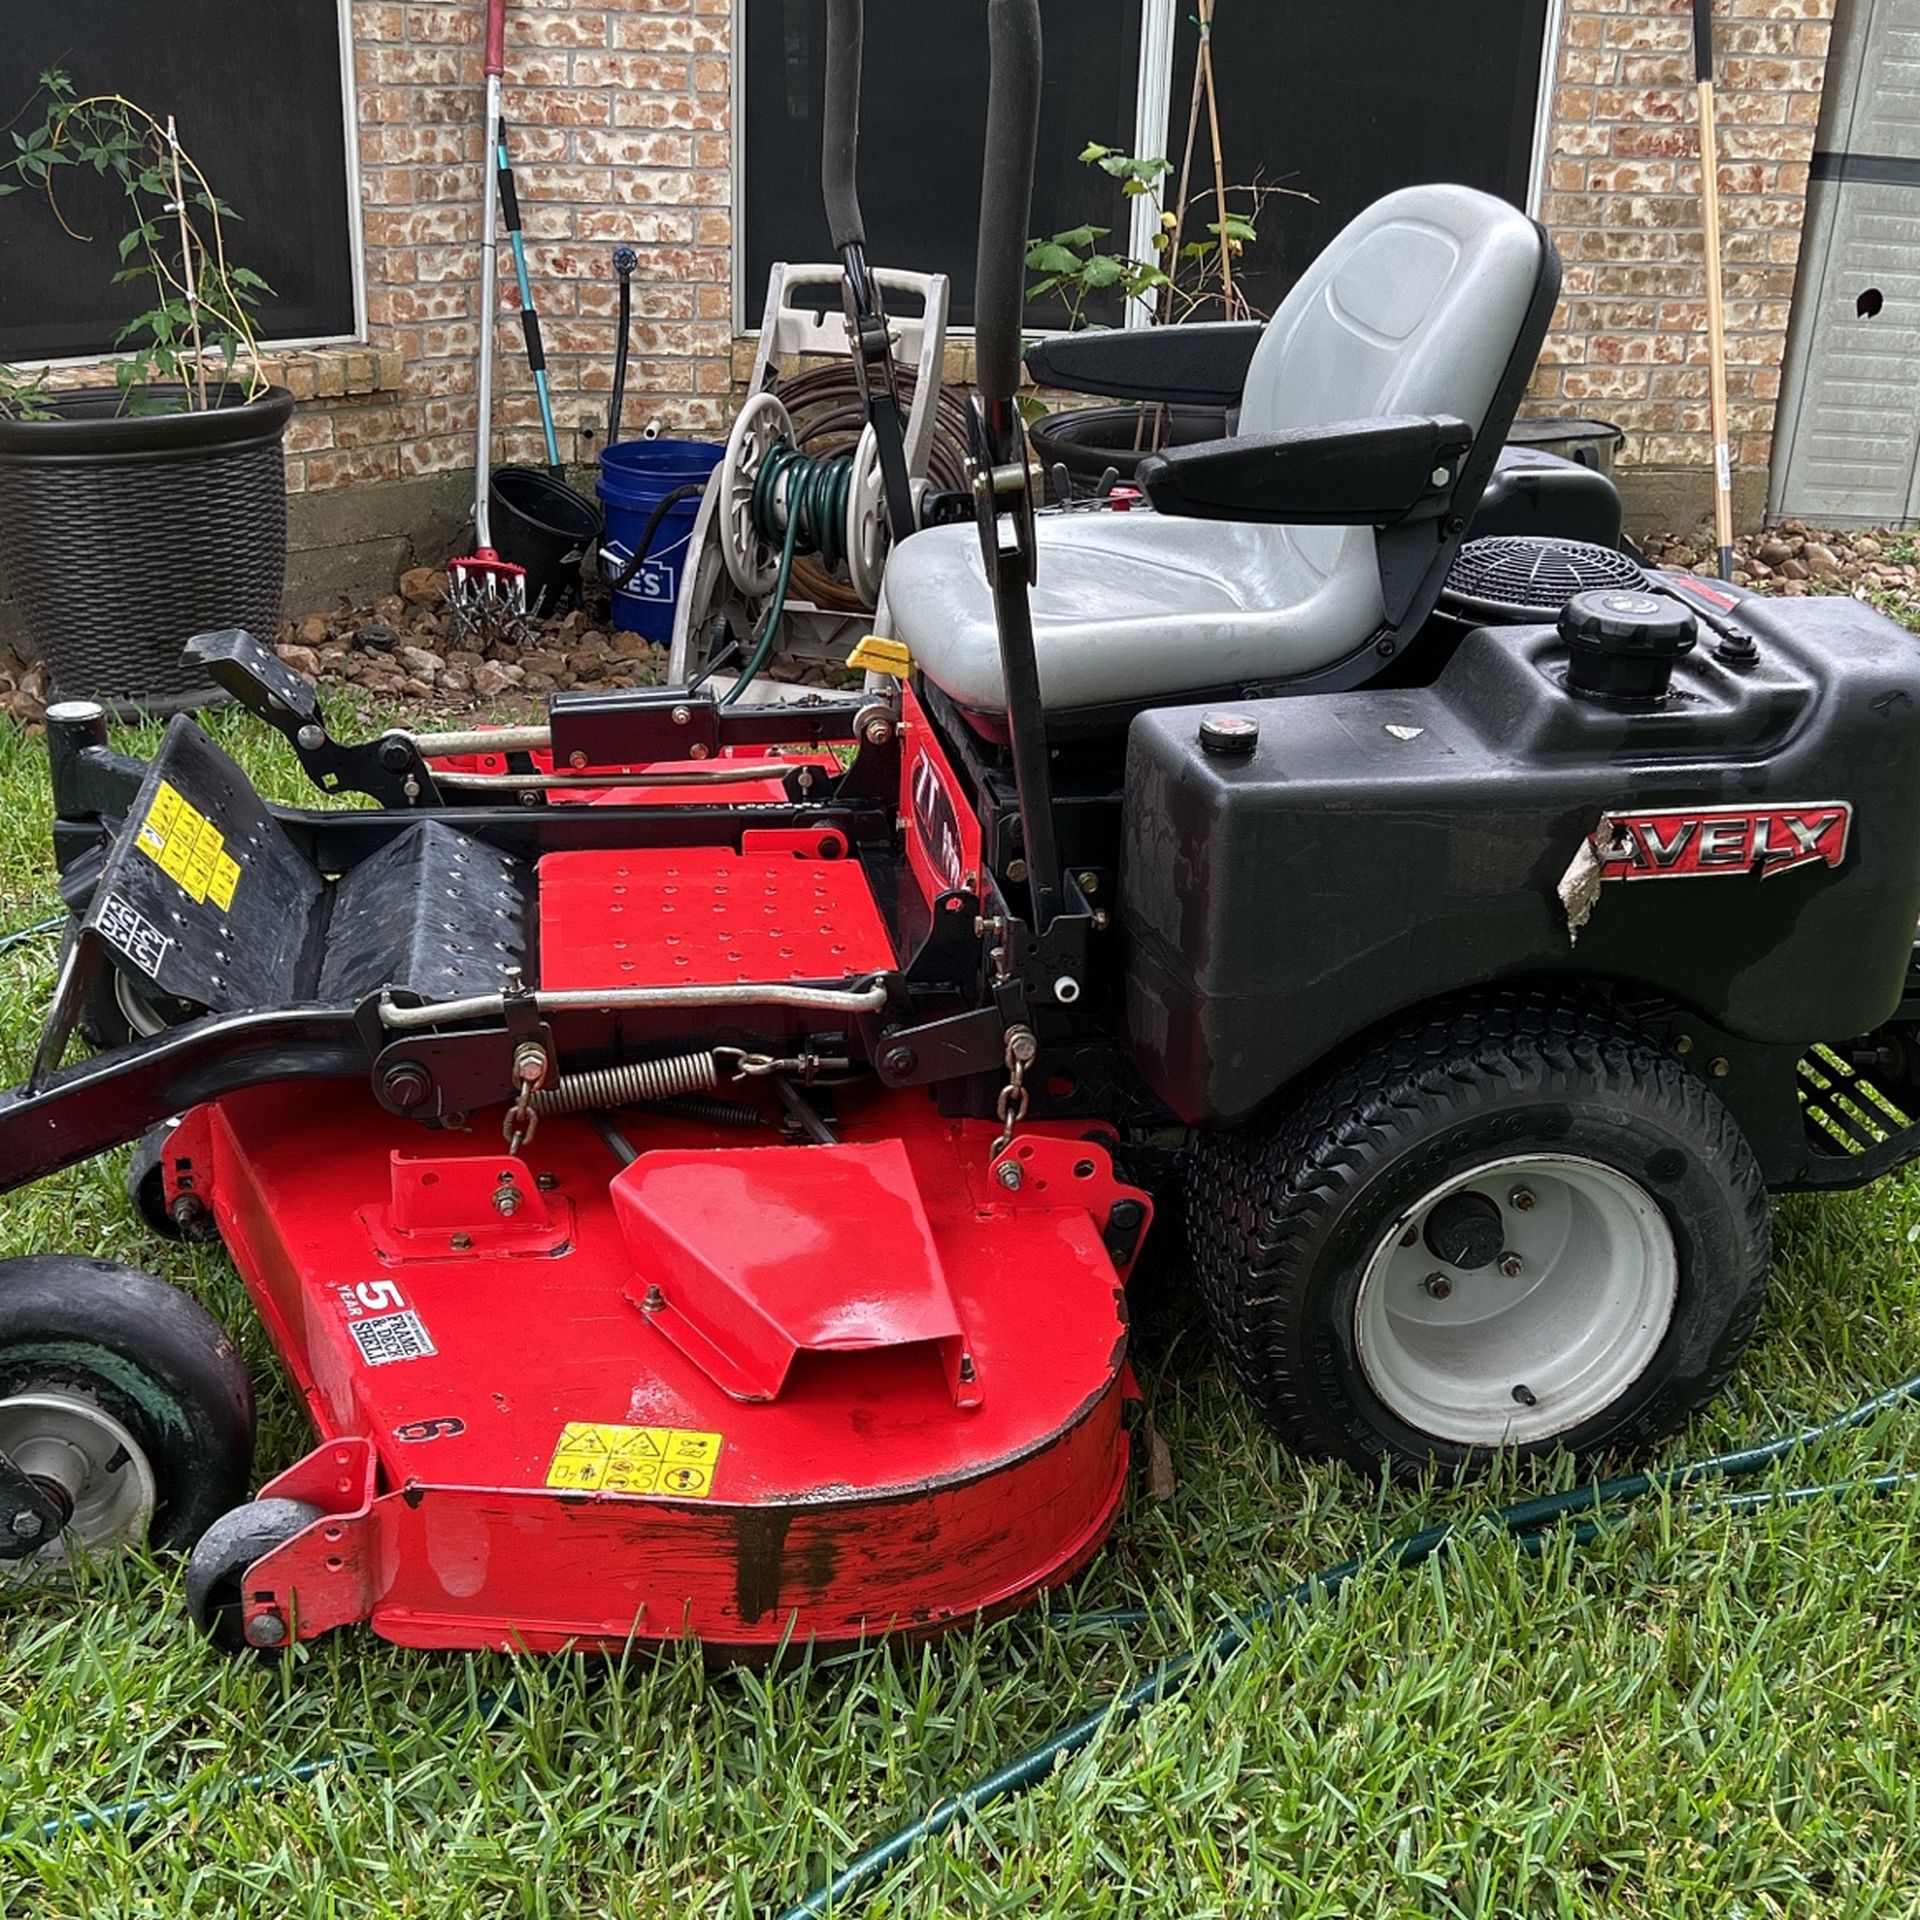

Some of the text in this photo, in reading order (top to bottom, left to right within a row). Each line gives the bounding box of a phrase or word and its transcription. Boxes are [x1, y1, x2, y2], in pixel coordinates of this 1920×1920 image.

[338, 1284, 363, 1317] YEAR
[356, 1279, 406, 1310] 5
[371, 1318, 406, 1358] & DECK
[387, 1313, 422, 1356] FRAME
